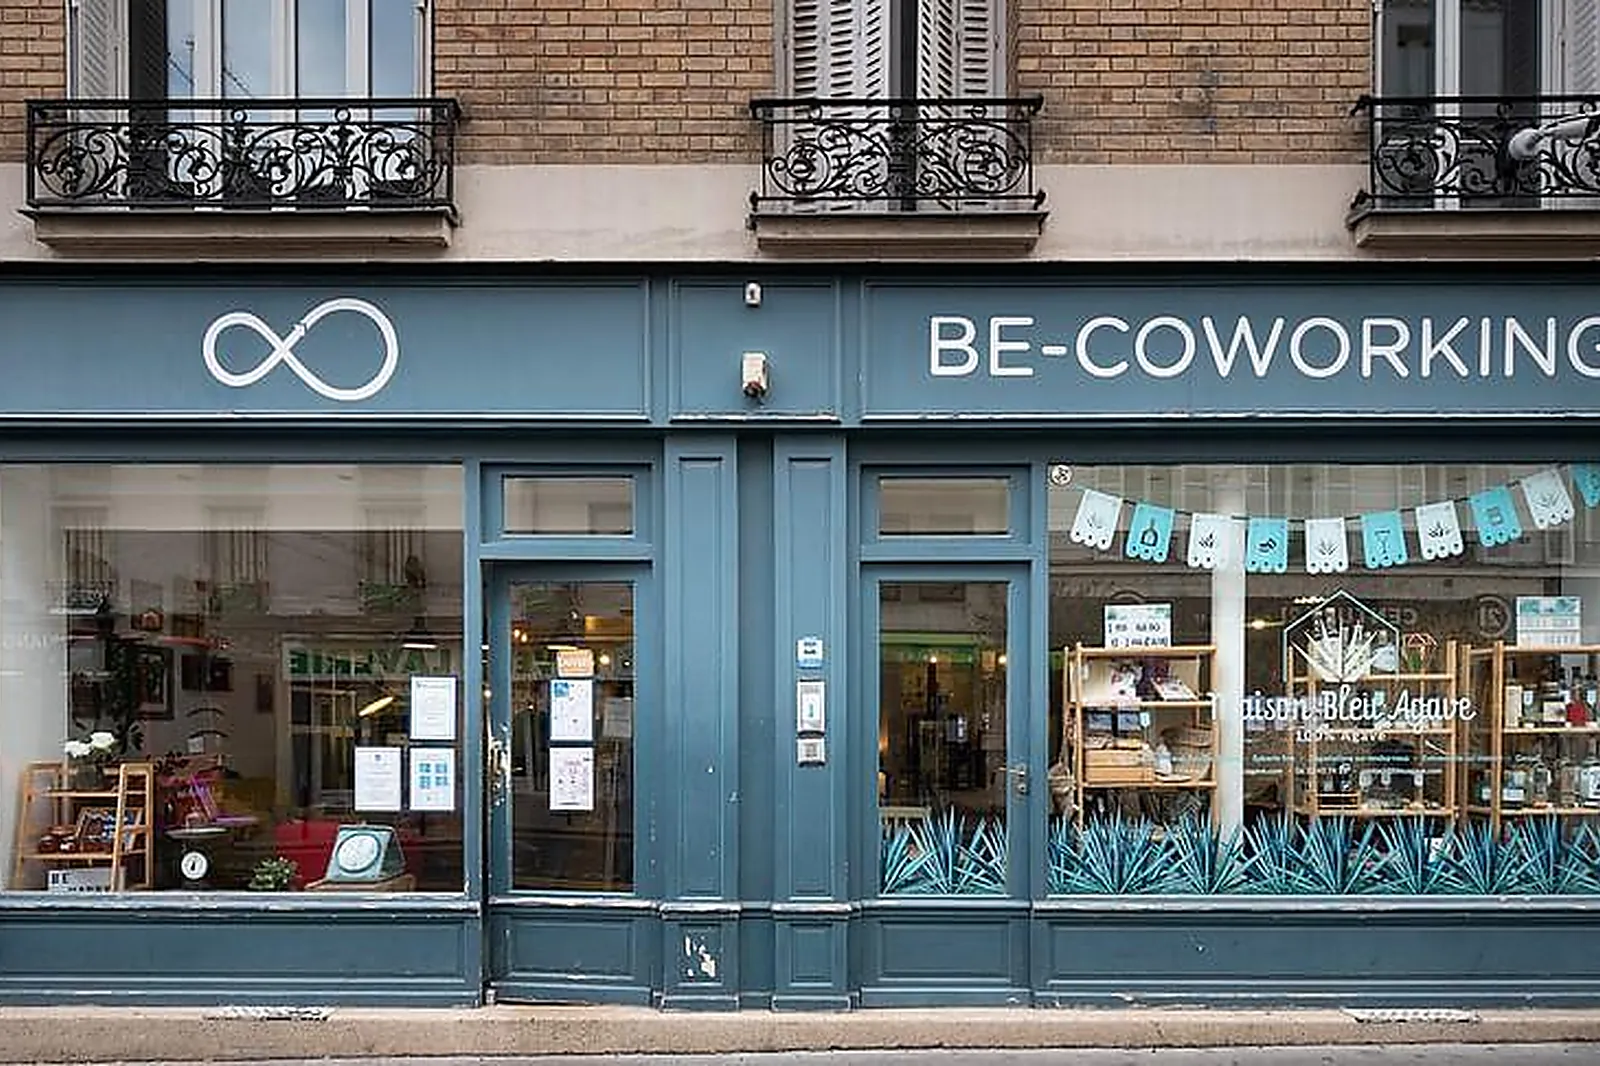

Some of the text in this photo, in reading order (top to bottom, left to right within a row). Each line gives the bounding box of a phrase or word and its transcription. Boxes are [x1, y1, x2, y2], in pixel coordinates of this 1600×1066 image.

[929, 316, 1600, 378] BE-COWORKING
[1321, 684, 1385, 721] Bleu
[1388, 690, 1477, 734] Agave
